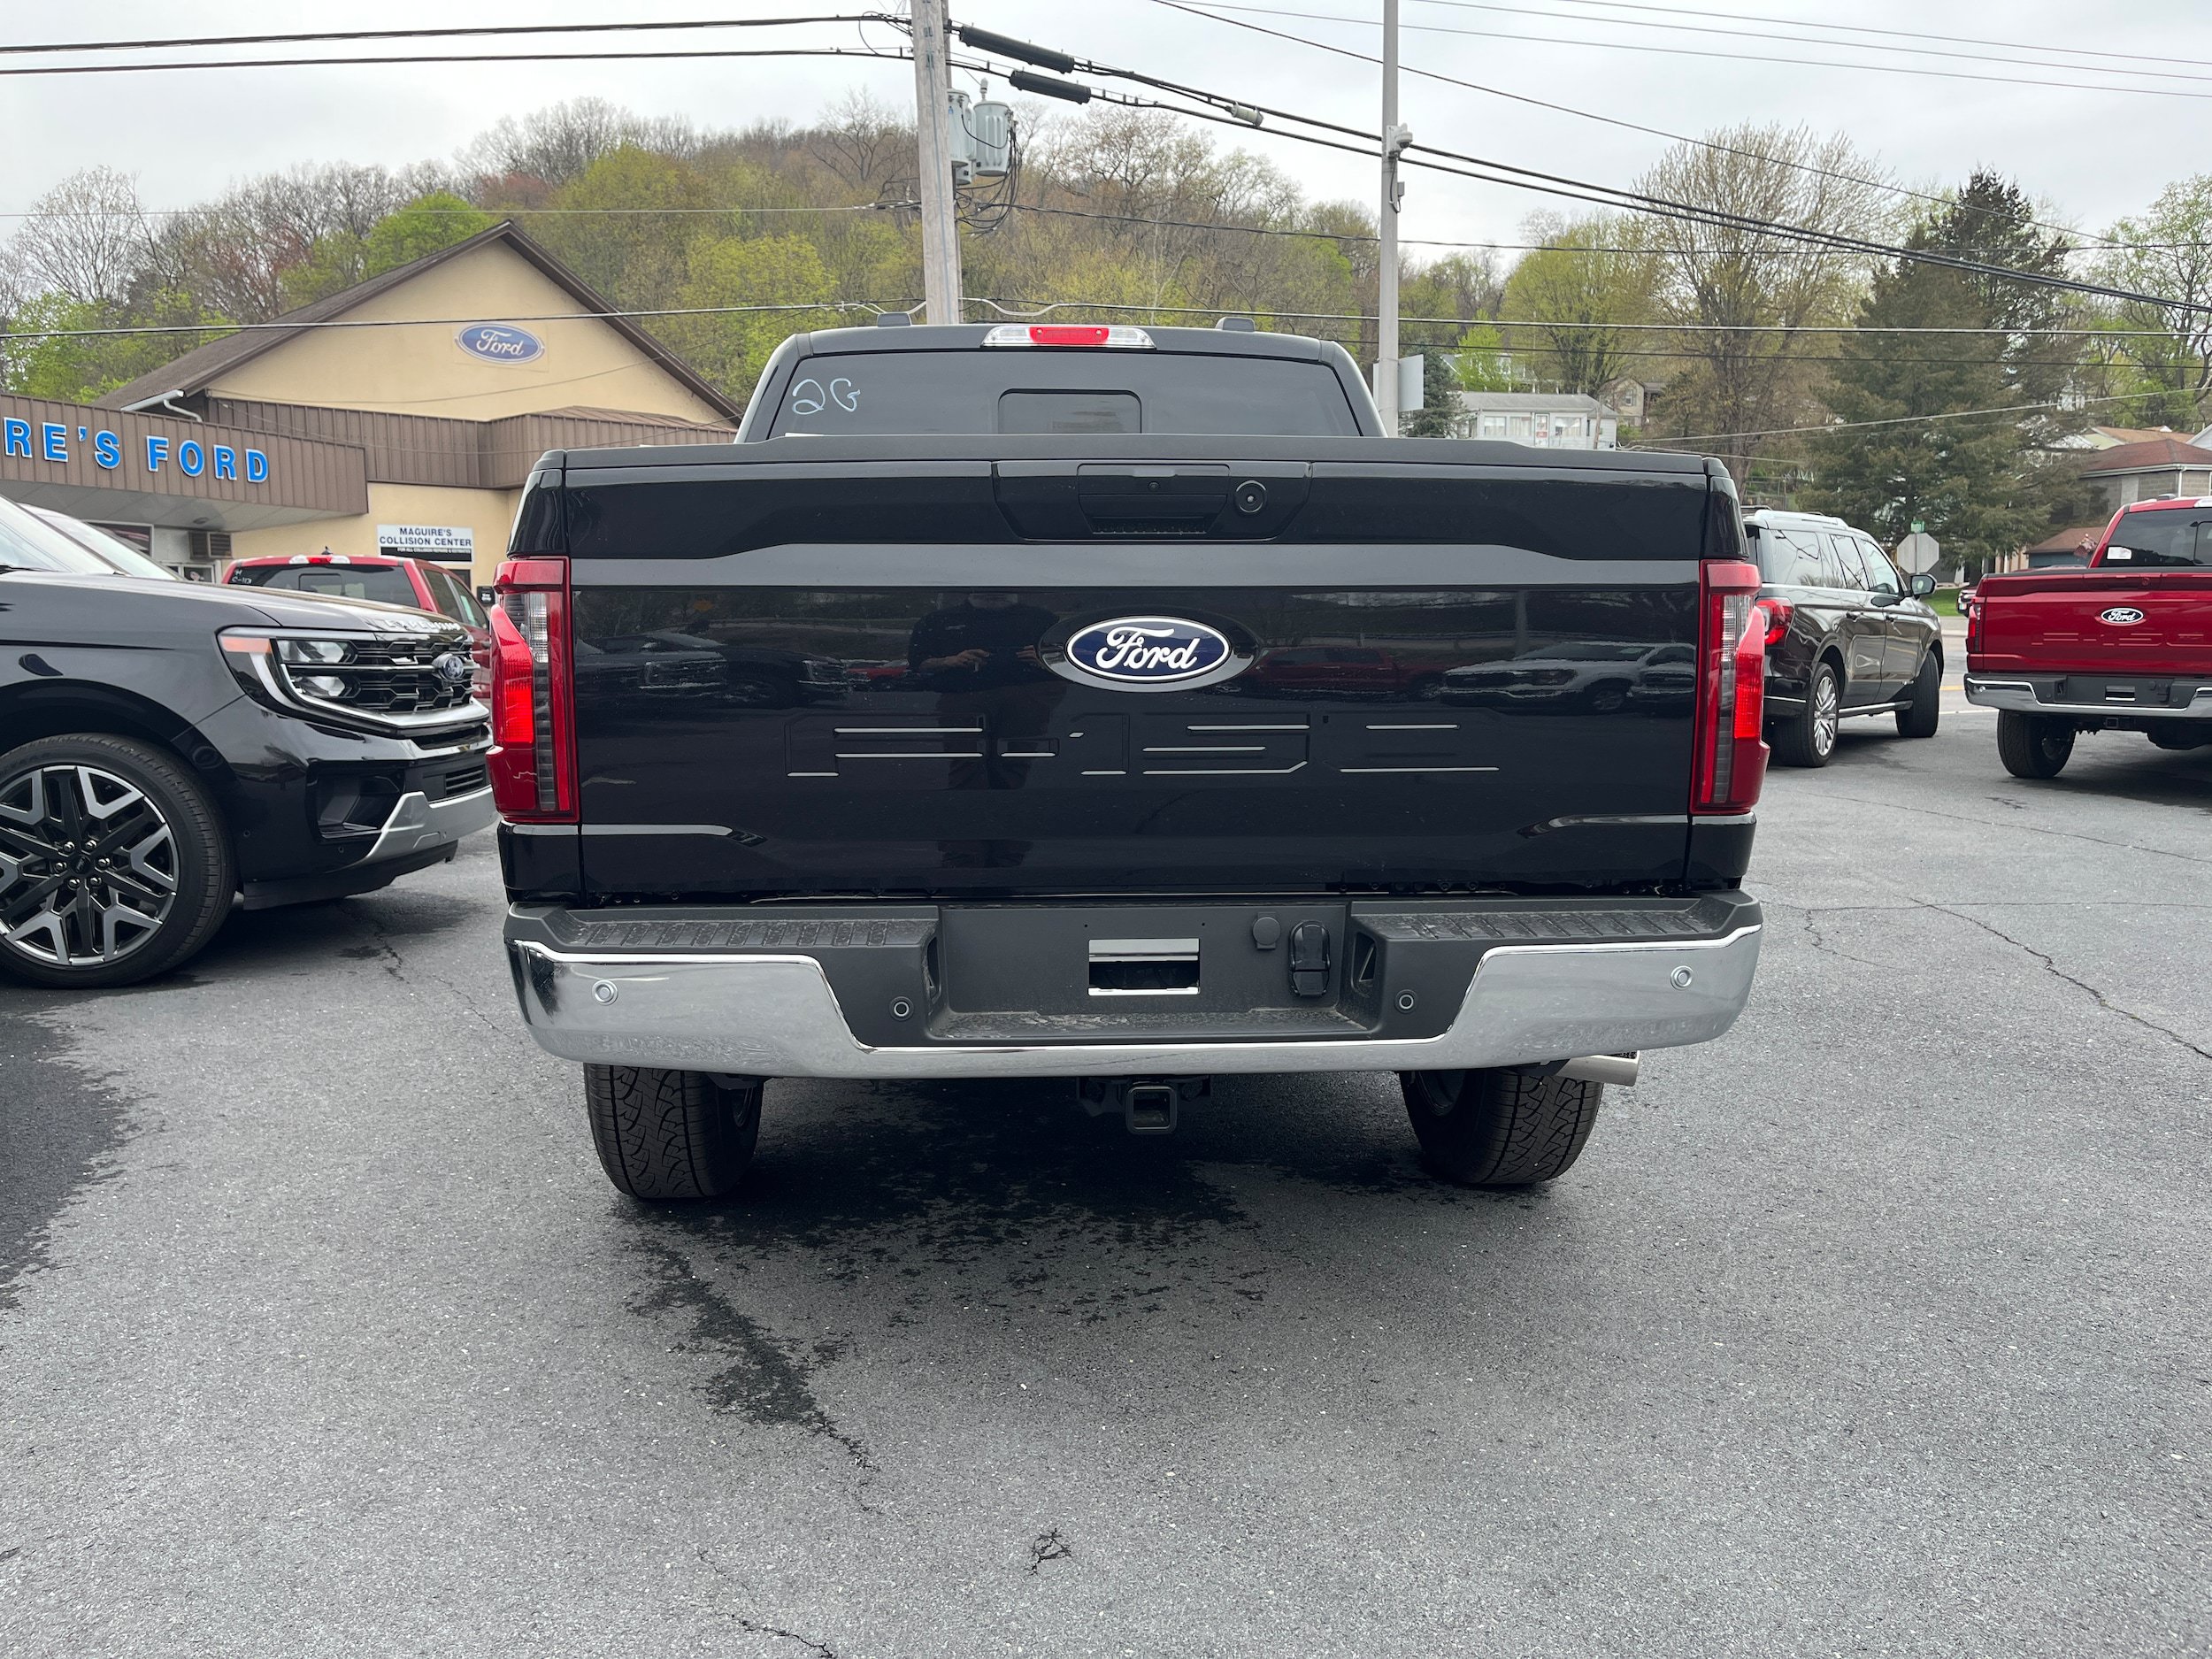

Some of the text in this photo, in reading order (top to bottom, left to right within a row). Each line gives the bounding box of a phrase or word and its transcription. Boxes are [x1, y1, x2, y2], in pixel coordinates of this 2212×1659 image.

[476, 329, 524, 356] Ford
[147, 435, 269, 483] FORD
[399, 527, 452, 536] MAGUIRE'S
[380, 536, 472, 547] COLLISION CENTER
[2108, 610, 2137, 622] Ford
[1095, 626, 1202, 670] Ford
